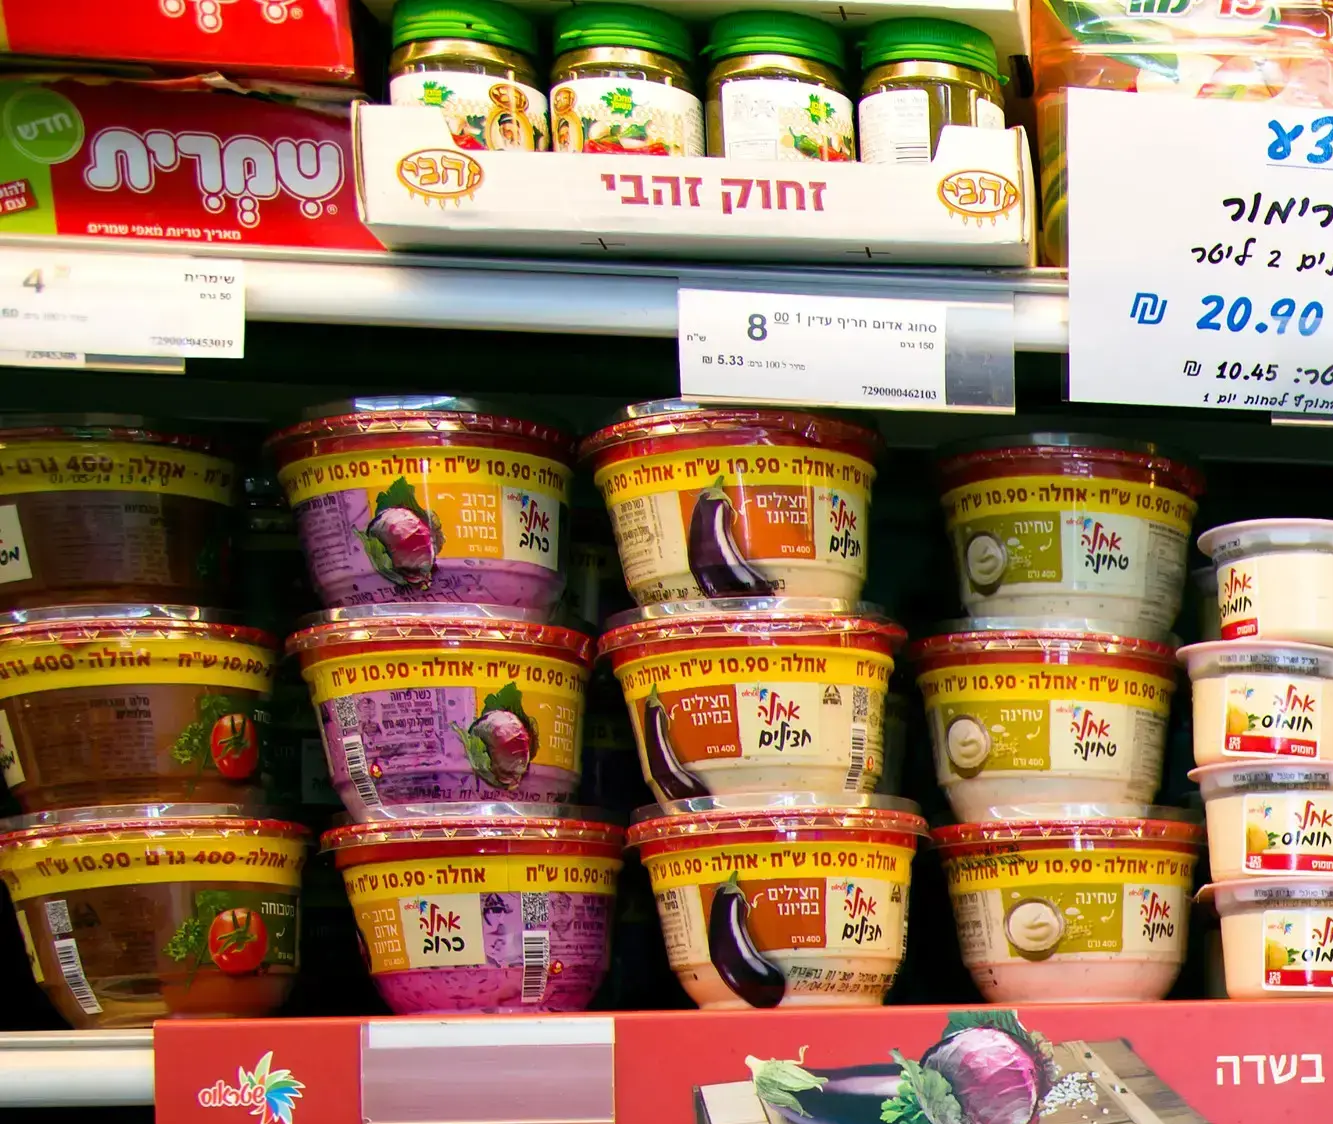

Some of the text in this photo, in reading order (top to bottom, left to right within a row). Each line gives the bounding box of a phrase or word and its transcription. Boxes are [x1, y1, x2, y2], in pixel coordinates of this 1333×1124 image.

[403, 155, 483, 190] זהבי
[601, 174, 826, 214] זחוק זהבי
[1191, 238, 1256, 266] ליטר
[1268, 250, 1281, 268] 2
[808, 315, 832, 328] עדין
[837, 318, 867, 329] חריף
[873, 320, 902, 330] אדום
[1196, 295, 1323, 336] 20.90
[748, 314, 767, 341] 8
[718, 354, 744, 366] 5.33
[1216, 362, 1278, 381] 10.45
[862, 385, 937, 399] 7290000462103
[1217, 393, 1236, 403] יום
[1244, 393, 1289, 406] לפחות
[757, 492, 807, 509] חצילים
[767, 509, 808, 524] במיונז
[680, 654, 826, 677] אחלה 10.90 ש"ח
[758, 692, 800, 726] אחלה
[1000, 708, 1043, 722] טחינה
[1070, 710, 1110, 741] אחלה
[759, 721, 812, 752] חצילים
[1074, 741, 1117, 761] טחינה
[1217, 1054, 1325, 1085] בשדה
